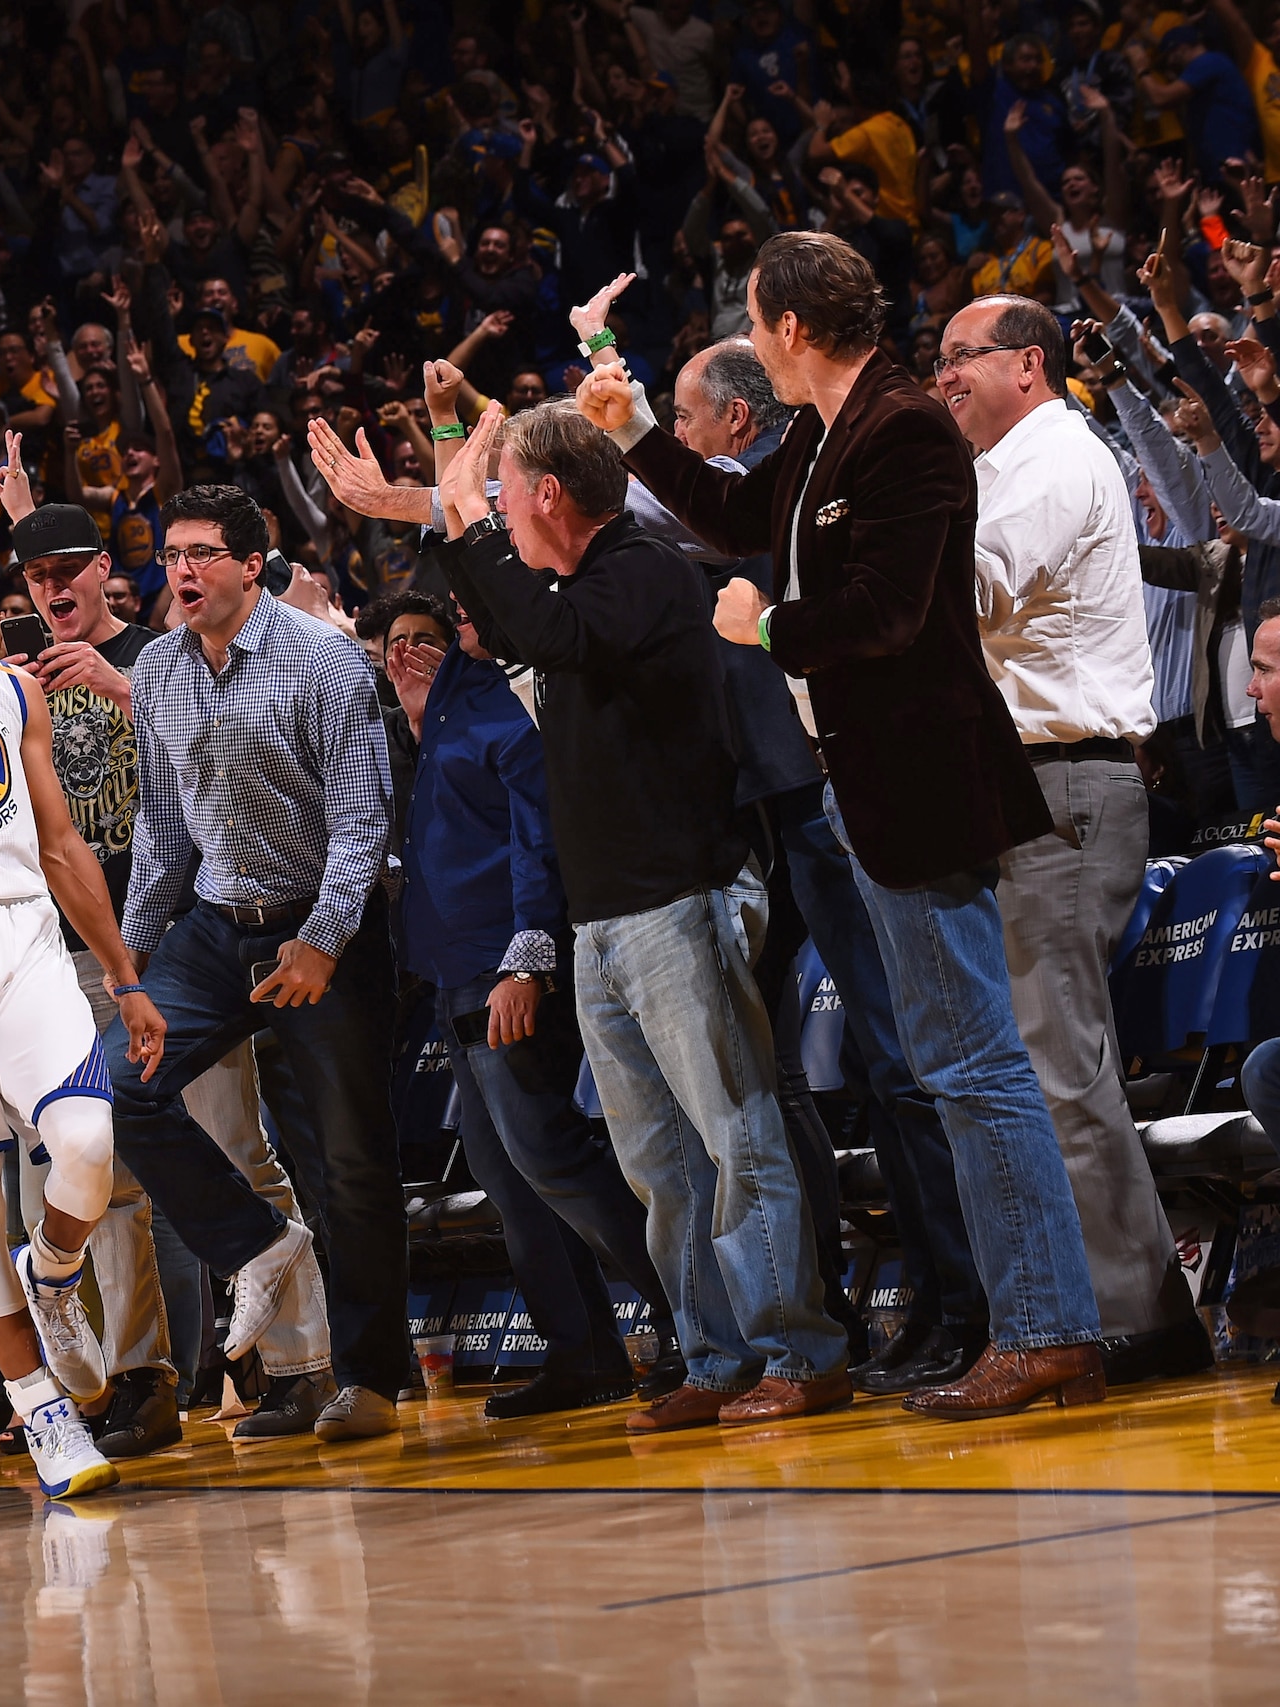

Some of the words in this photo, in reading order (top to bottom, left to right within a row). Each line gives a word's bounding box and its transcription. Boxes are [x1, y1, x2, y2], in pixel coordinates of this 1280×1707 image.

[1140, 908, 1218, 946] AMERICAN
[1135, 936, 1205, 968] EXPRESS
[449, 1312, 506, 1331] AMERICAN
